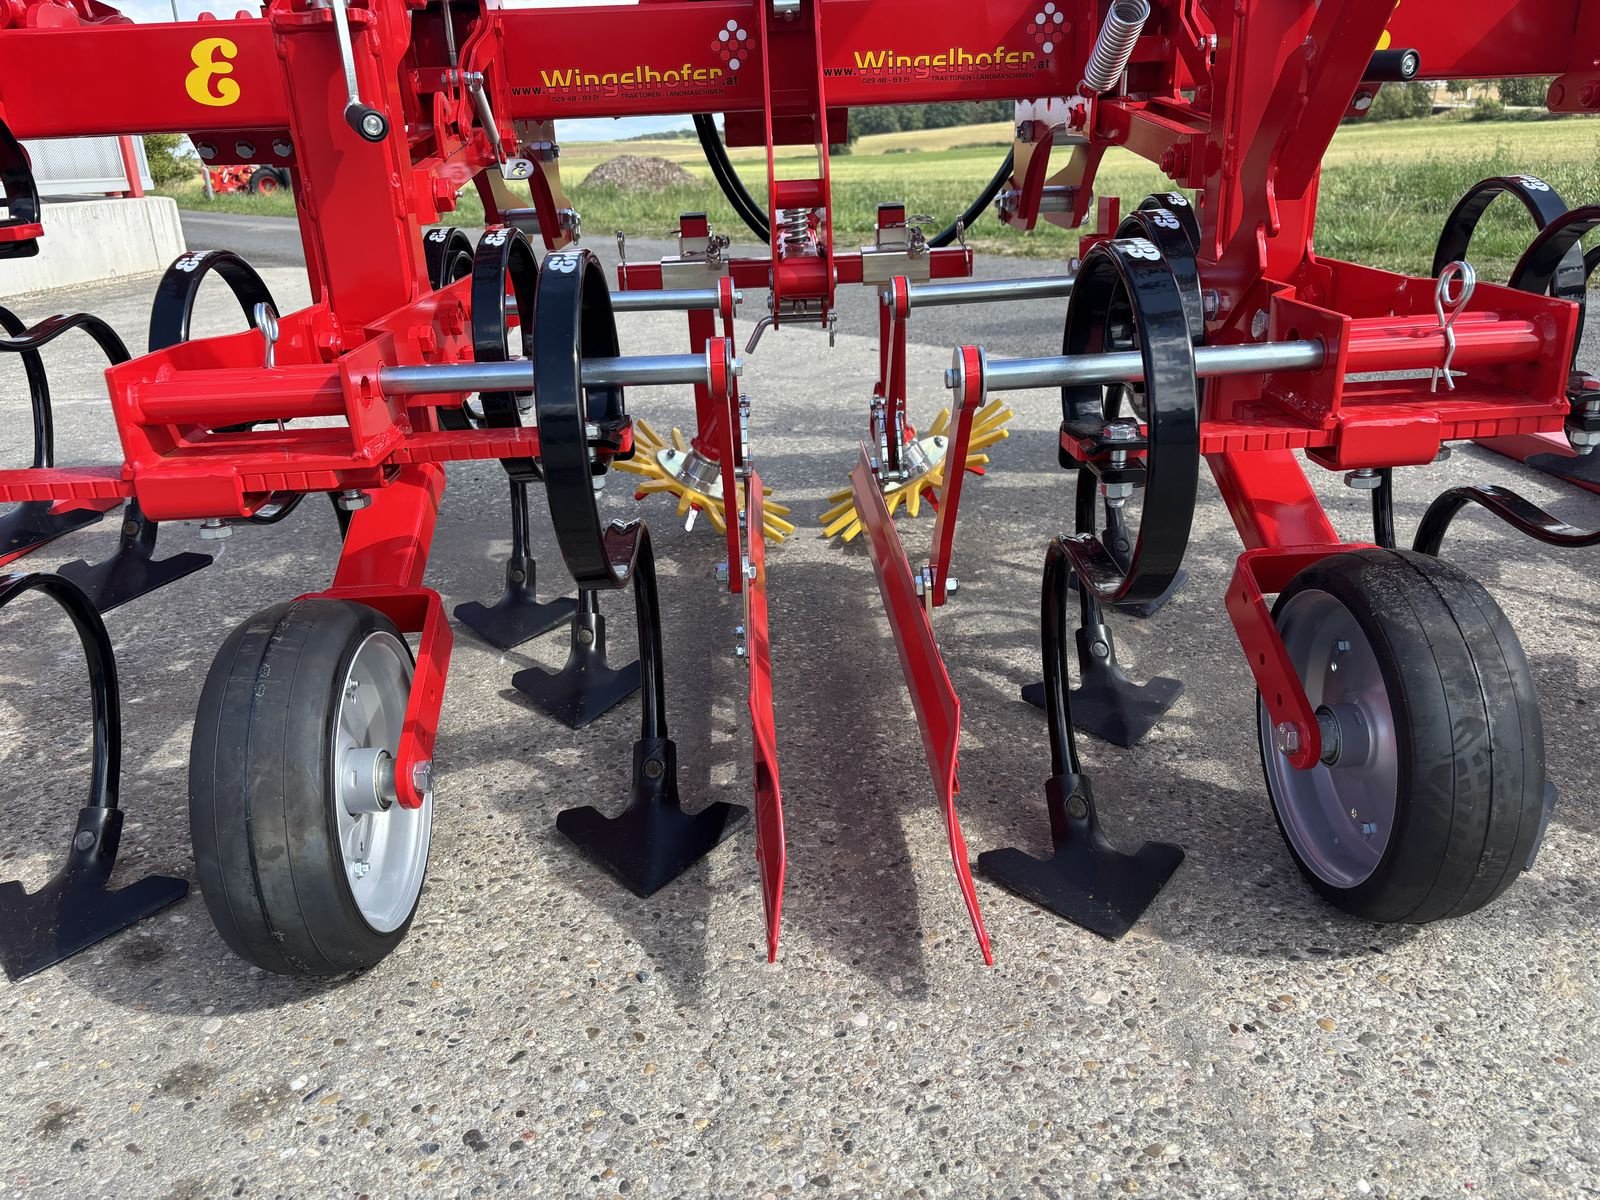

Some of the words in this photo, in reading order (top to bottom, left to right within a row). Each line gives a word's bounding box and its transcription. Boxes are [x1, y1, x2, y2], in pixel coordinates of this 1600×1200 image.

[931, 74, 972, 82] TRAKTOREN
[976, 72, 1034, 81] LANDMASCHINEN
[620, 91, 661, 100] TRAKTOREN
[665, 88, 724, 97] LANDMASCHINEN
